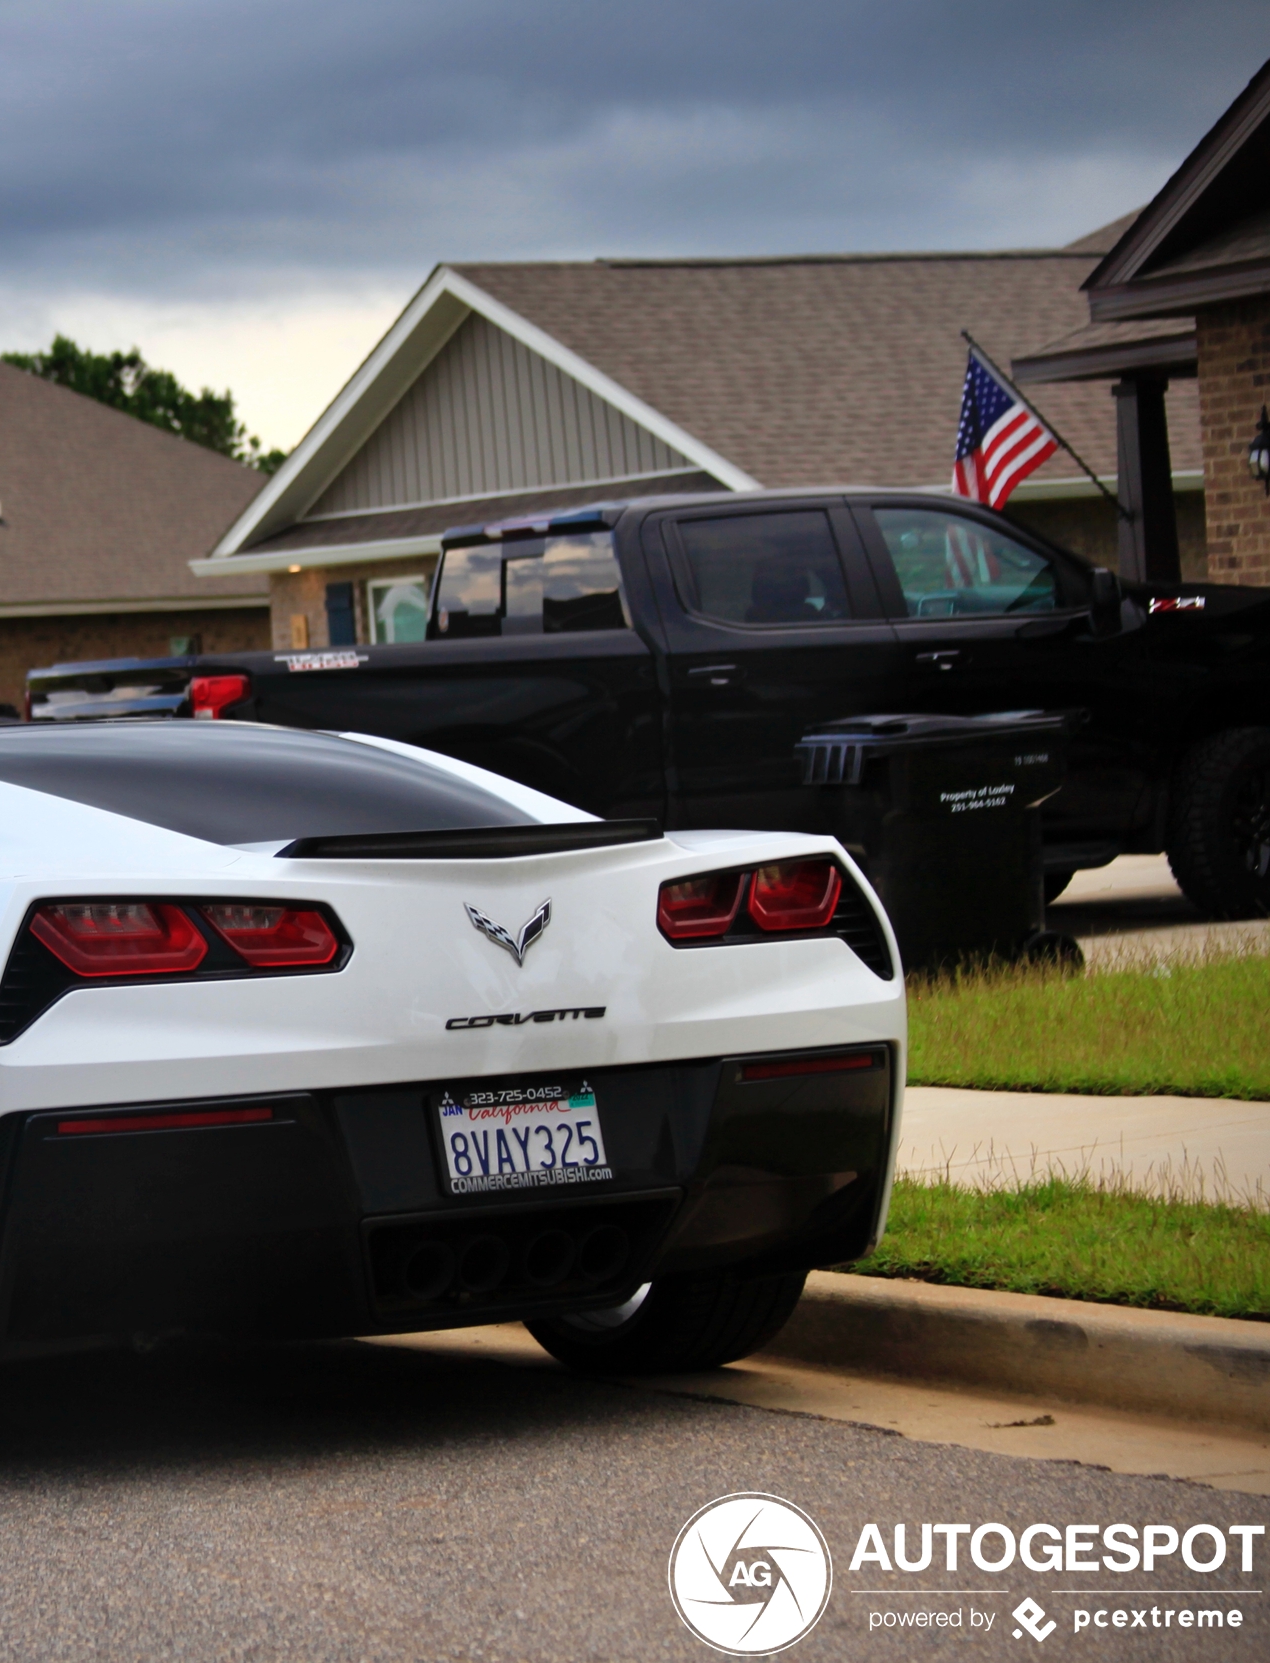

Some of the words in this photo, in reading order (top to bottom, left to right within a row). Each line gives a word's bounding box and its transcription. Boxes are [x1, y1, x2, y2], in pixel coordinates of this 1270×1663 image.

[940, 788, 977, 802] Property
[977, 785, 988, 797] of
[445, 1006, 606, 1030] CORVETTE
[469, 1086, 562, 1105] 323-725-0452
[443, 1104, 463, 1117] JAN
[468, 1101, 572, 1125] California
[450, 1120, 599, 1176] 8VAY325
[450, 1167, 612, 1194] COMMERCEMITSUBISHI.com
